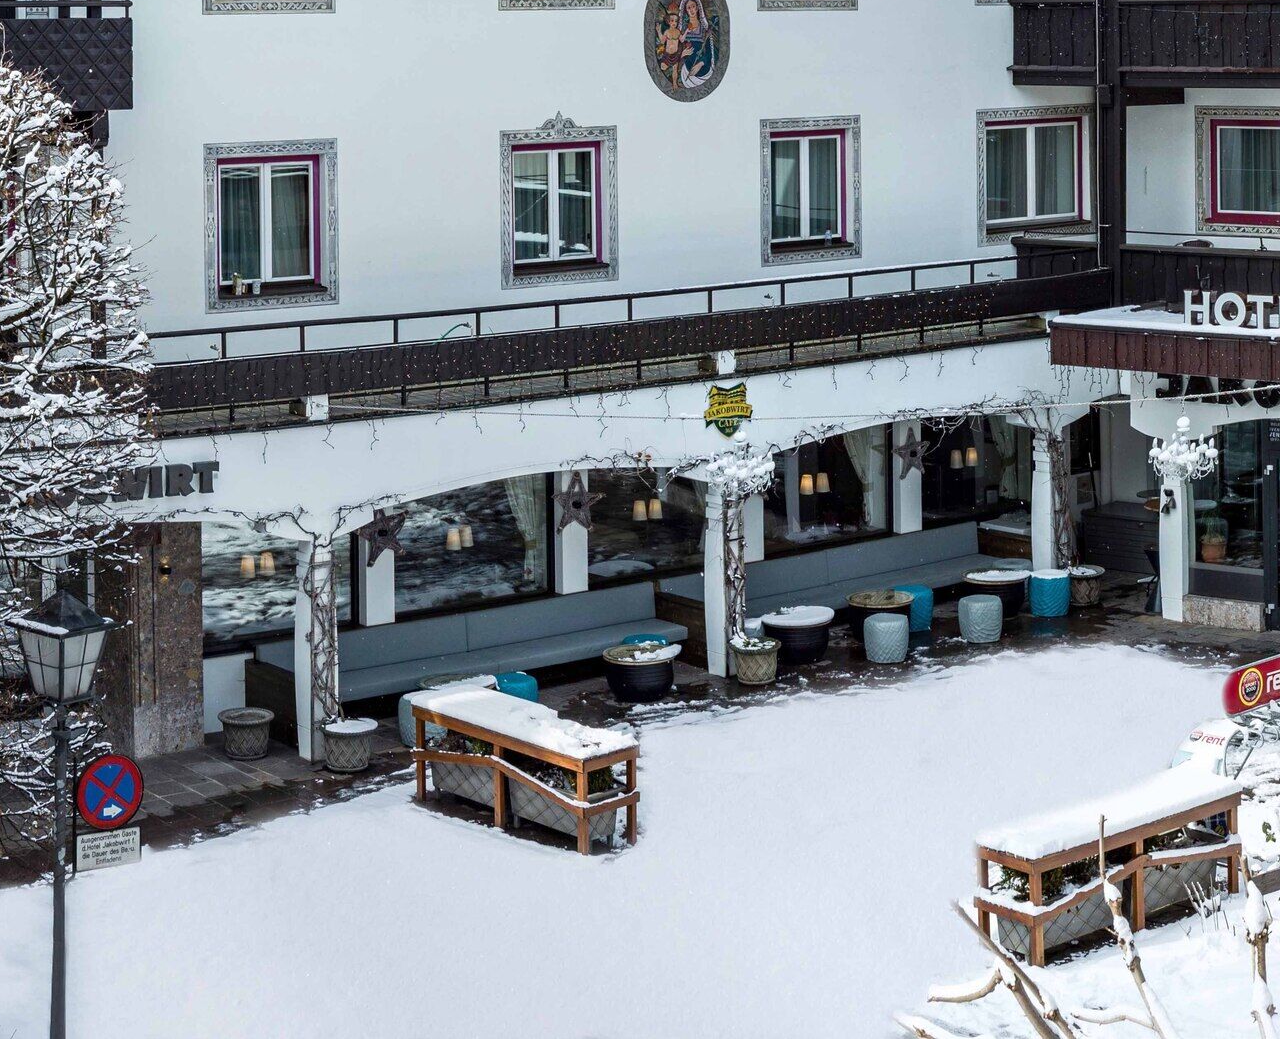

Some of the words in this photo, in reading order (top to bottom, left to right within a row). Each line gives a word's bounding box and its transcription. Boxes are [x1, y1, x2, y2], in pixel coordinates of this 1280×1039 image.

[708, 406, 750, 418] JAKOBWIRT
[1201, 733, 1226, 746] rent
[91, 850, 108, 858] Dauer
[109, 847, 120, 855] des
